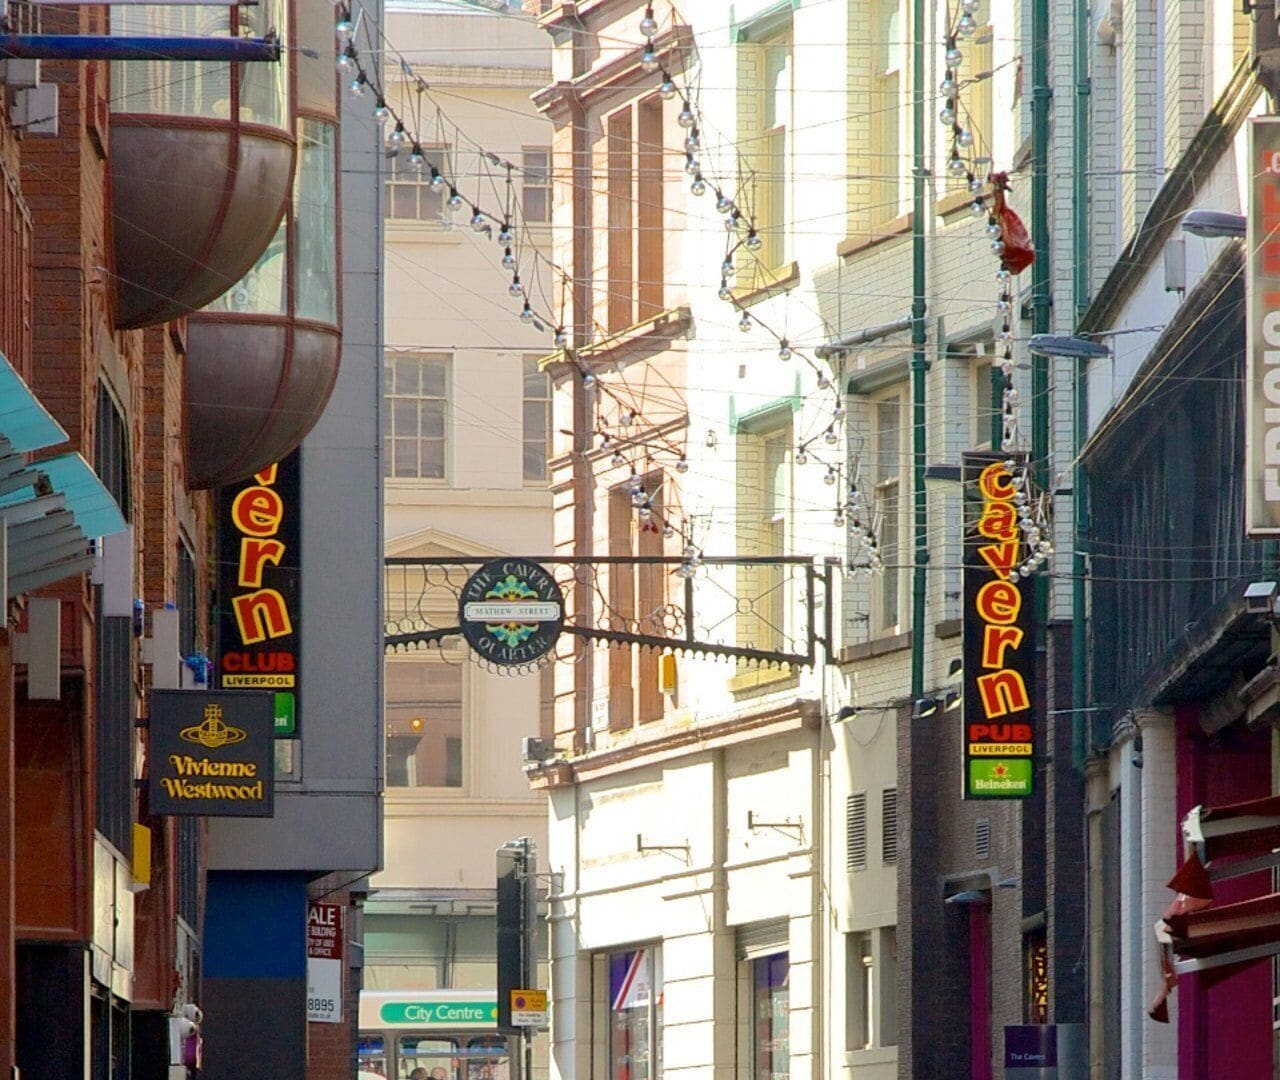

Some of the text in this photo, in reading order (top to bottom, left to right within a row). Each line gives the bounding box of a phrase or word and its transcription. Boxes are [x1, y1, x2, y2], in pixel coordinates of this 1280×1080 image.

[976, 460, 1031, 719] cavern
[519, 607, 550, 615] STREET
[478, 636, 549, 661] QUARTER
[222, 651, 295, 672] CLUB
[226, 677, 292, 686] LIVERPOOL
[969, 723, 1033, 742] PUB
[972, 744, 1030, 754] LIVERPOOL
[168, 754, 257, 778] Vivienne
[161, 777, 263, 800] Westwood
[975, 779, 1027, 790] Heineken
[308, 906, 336, 926] ALE
[404, 1005, 483, 1022] City Centre
